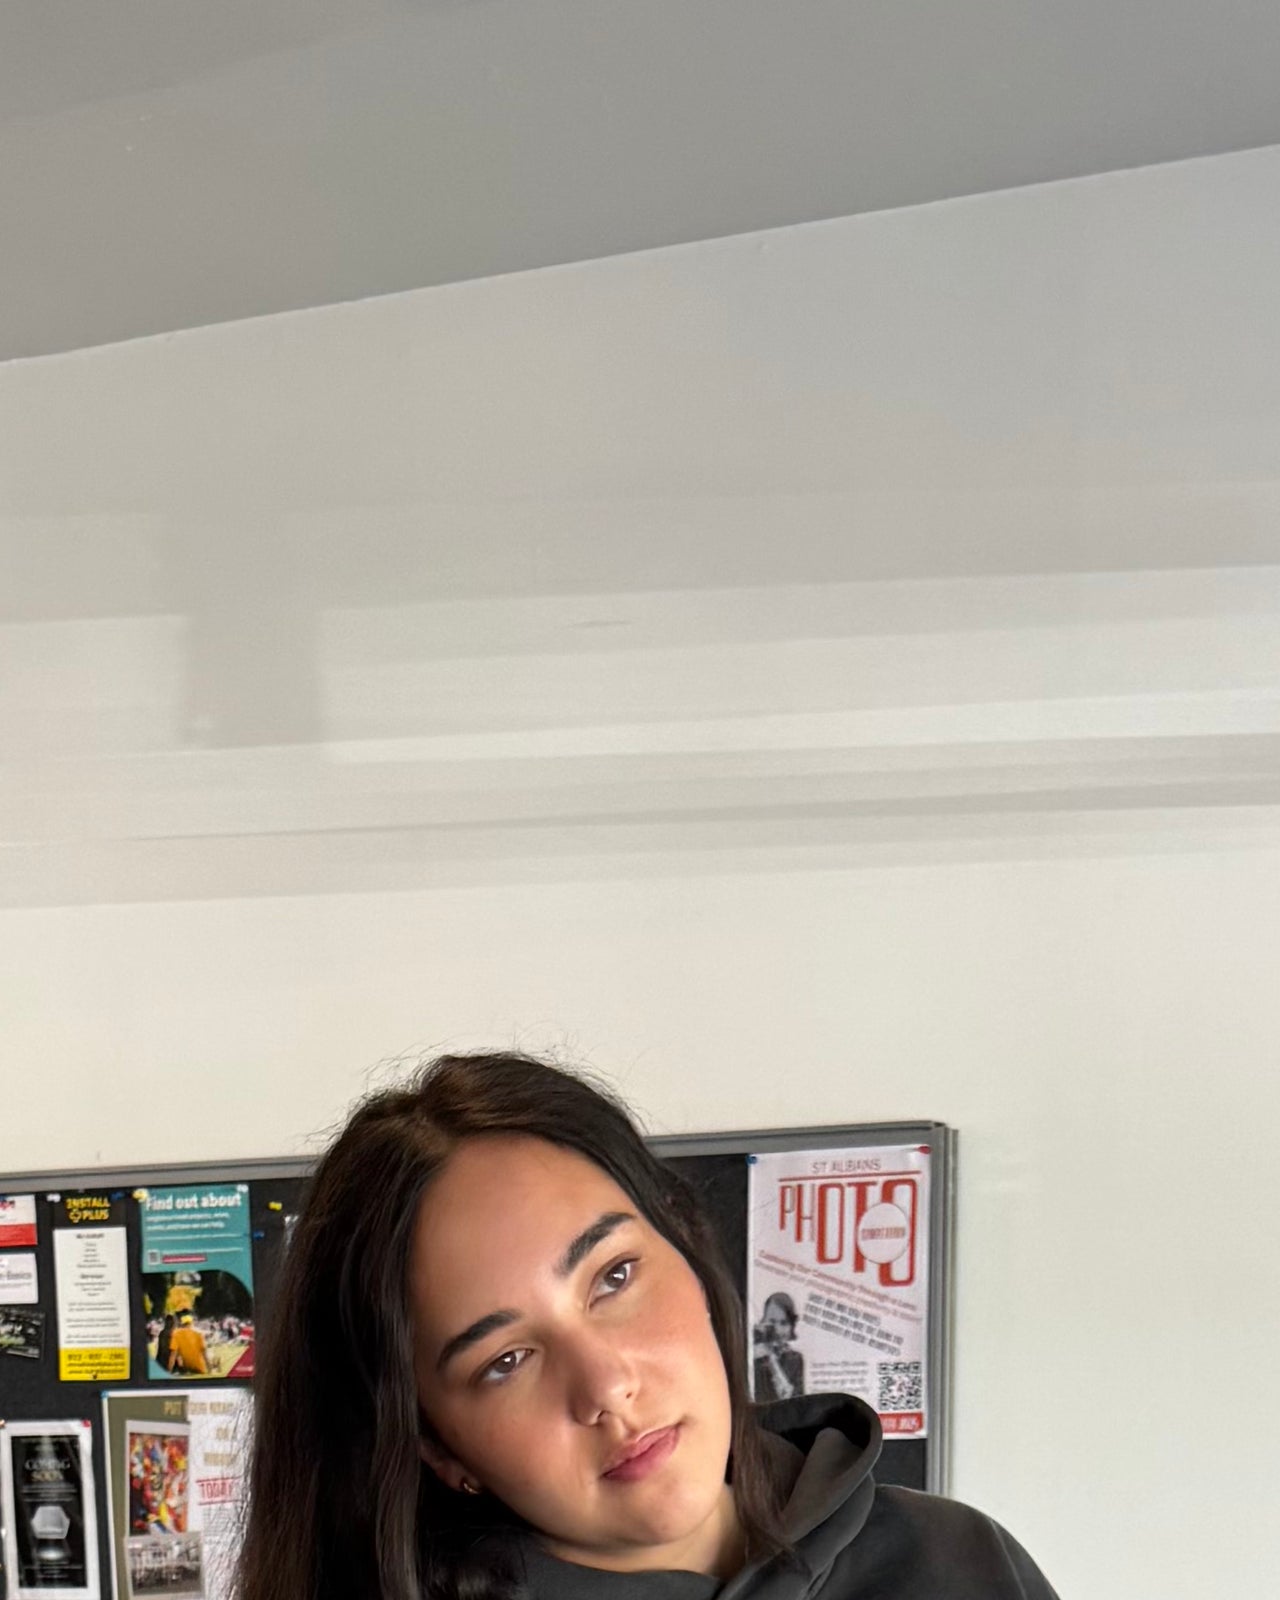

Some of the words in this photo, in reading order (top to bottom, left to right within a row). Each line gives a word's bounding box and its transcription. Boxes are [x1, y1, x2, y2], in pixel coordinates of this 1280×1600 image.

[145, 1194, 174, 1211] Find
[175, 1194, 199, 1209] out
[201, 1192, 242, 1208] about
[778, 1178, 918, 1288] PHOTO
